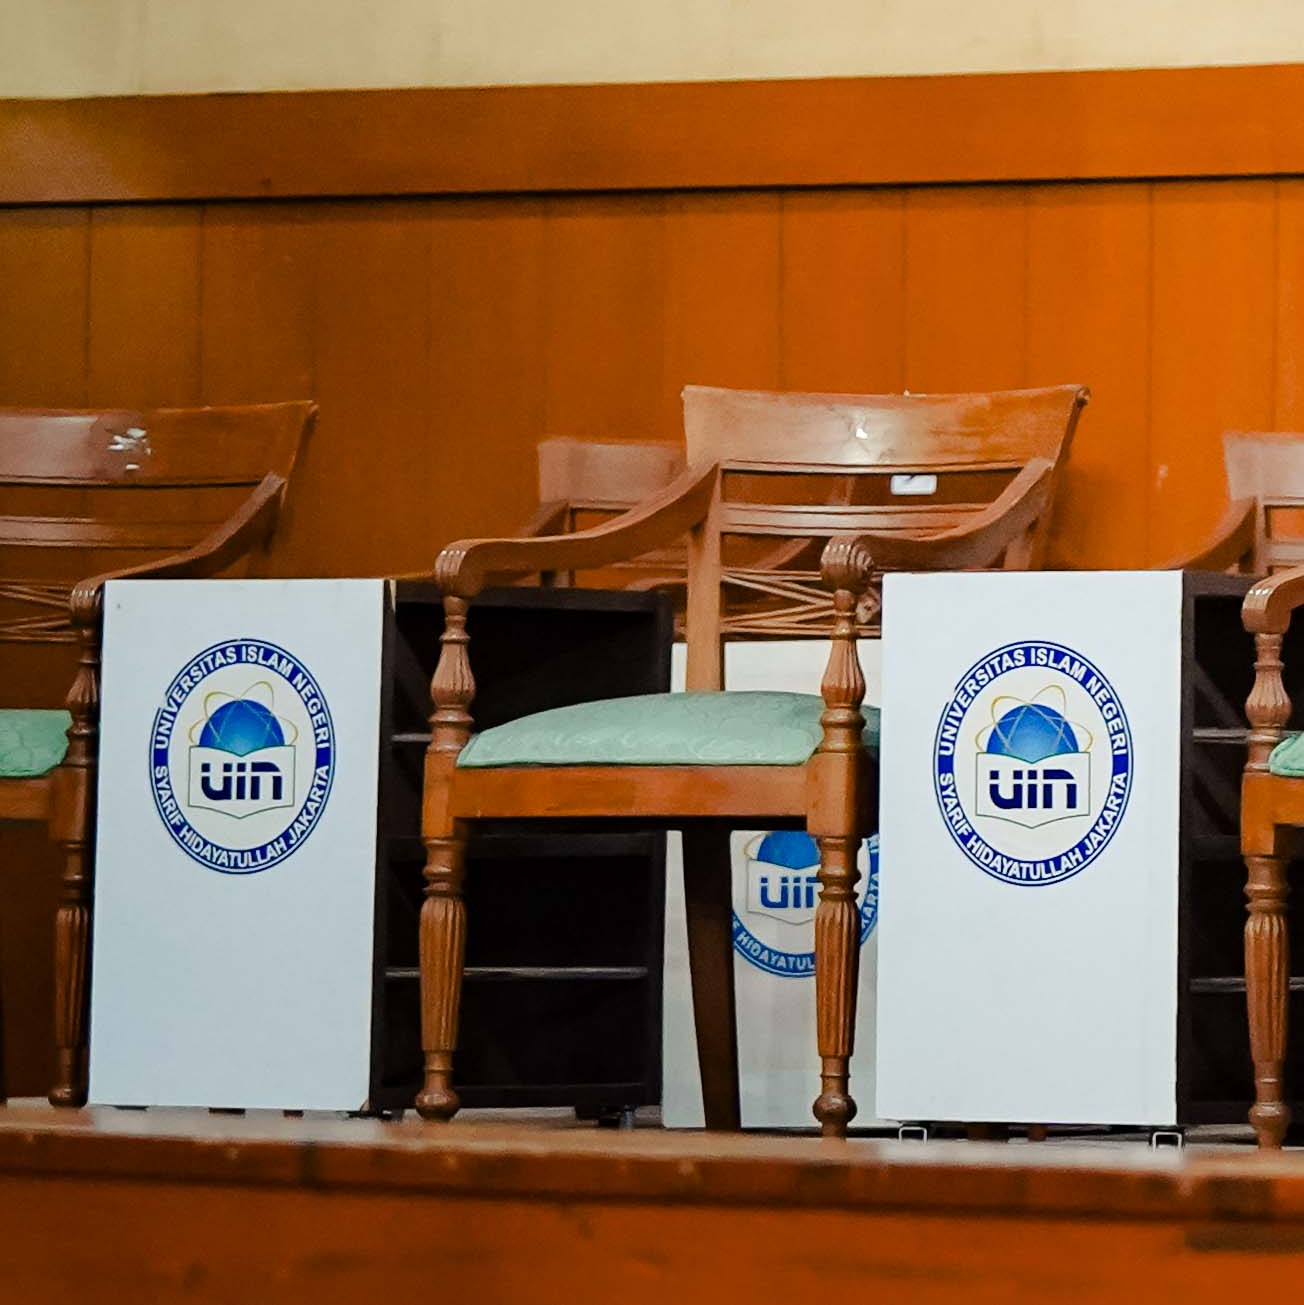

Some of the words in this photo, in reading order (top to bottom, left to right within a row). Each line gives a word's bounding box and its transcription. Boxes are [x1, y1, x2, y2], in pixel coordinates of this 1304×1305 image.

[155, 646, 237, 750] UNIVERSITAS
[240, 645, 294, 675] ISLAM
[293, 674, 330, 749] NEGERI
[939, 648, 1027, 756] UNIVERSITAS
[1030, 647, 1088, 681] ISLAM
[1085, 673, 1128, 757] NEGERI
[154, 765, 183, 830] SYARIF
[179, 824, 289, 869] HIDAYATULLAH
[288, 764, 330, 847] JAKARTA
[939, 772, 972, 840] SYARIF
[967, 834, 1083, 881] HIDAYATULLAH
[1083, 771, 1128, 856] JAKARTA
